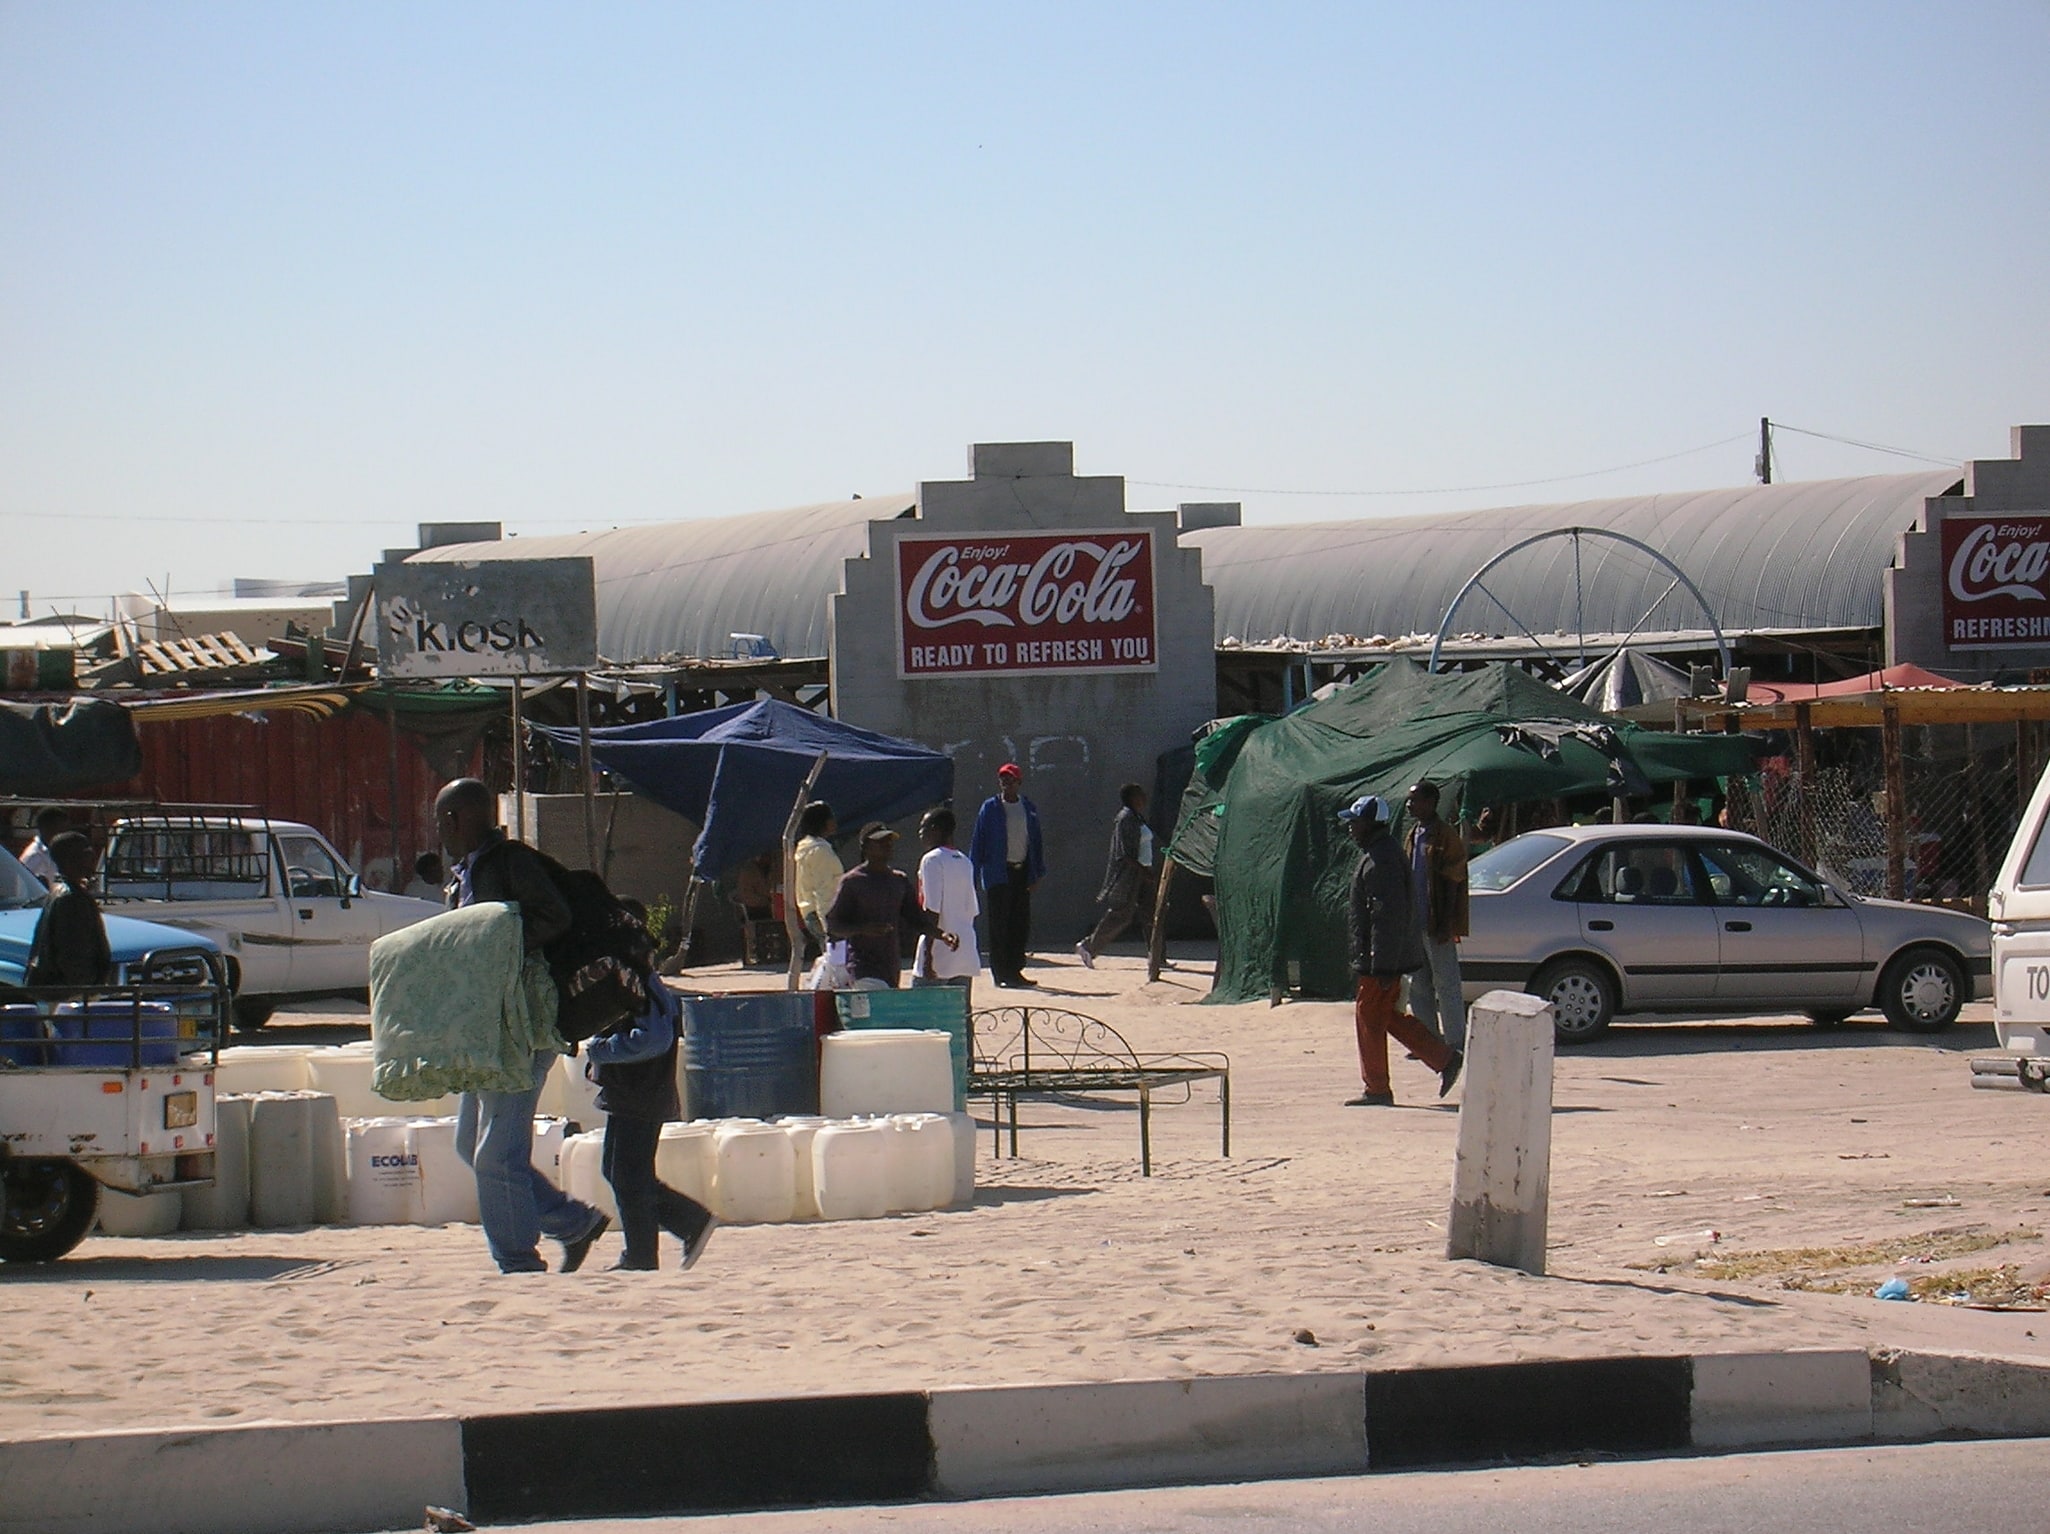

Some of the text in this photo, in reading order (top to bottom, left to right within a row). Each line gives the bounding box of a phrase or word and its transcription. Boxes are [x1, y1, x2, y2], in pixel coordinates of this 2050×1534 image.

[1997, 524, 2042, 538] Enjoy!
[960, 544, 1010, 561] Enjoy!
[1948, 524, 2050, 601] Coca
[907, 539, 1143, 629] Coca-Cola
[911, 637, 1148, 668] READY TO REFRESH YOU
[372, 1154, 418, 1168] ECOLB
